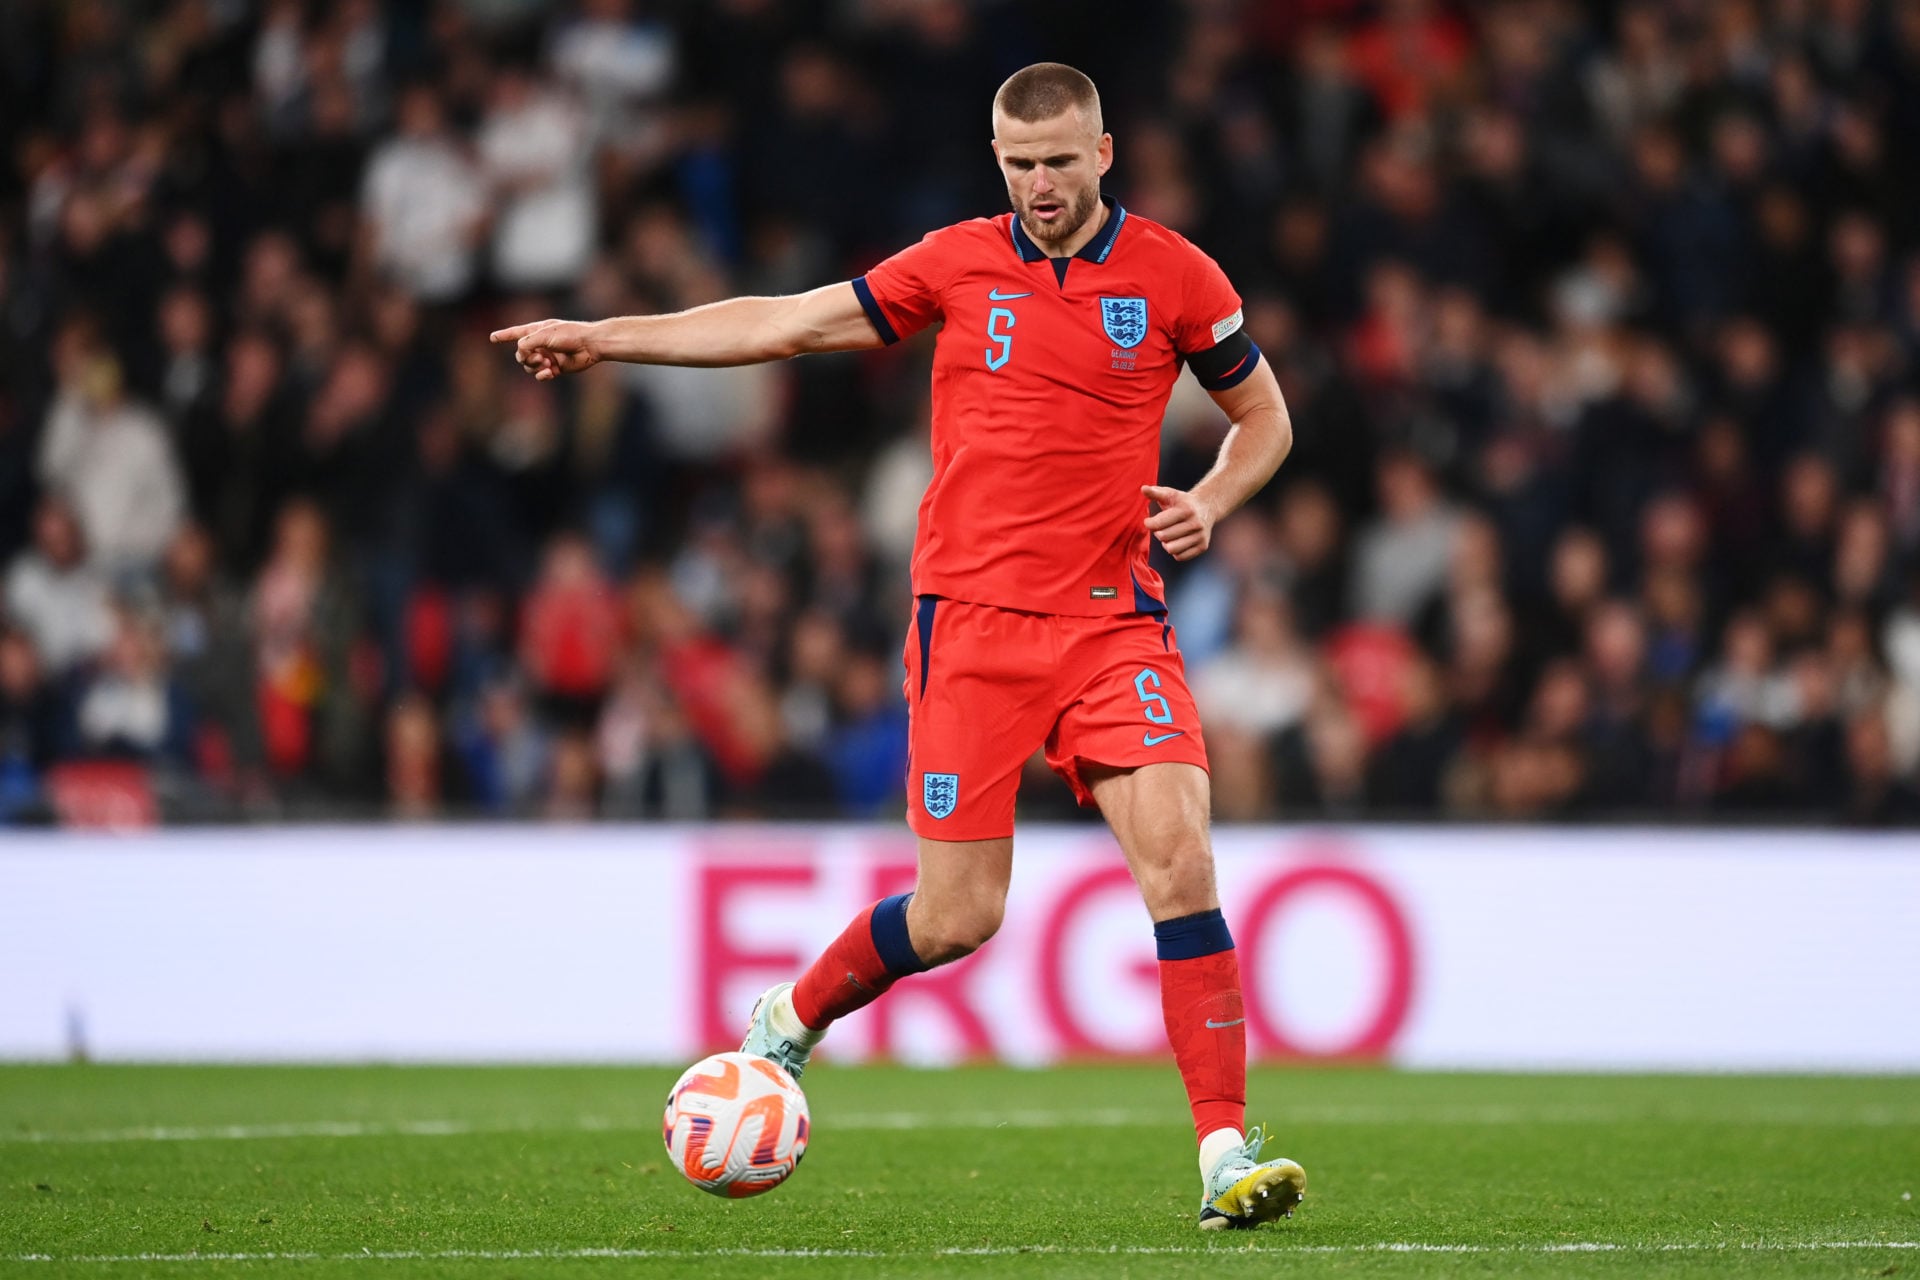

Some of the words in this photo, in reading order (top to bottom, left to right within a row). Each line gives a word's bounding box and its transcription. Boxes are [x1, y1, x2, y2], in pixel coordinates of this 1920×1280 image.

[985, 306, 1016, 372] 5
[1133, 667, 1174, 725] 5
[698, 860, 1417, 1063] ERGO
